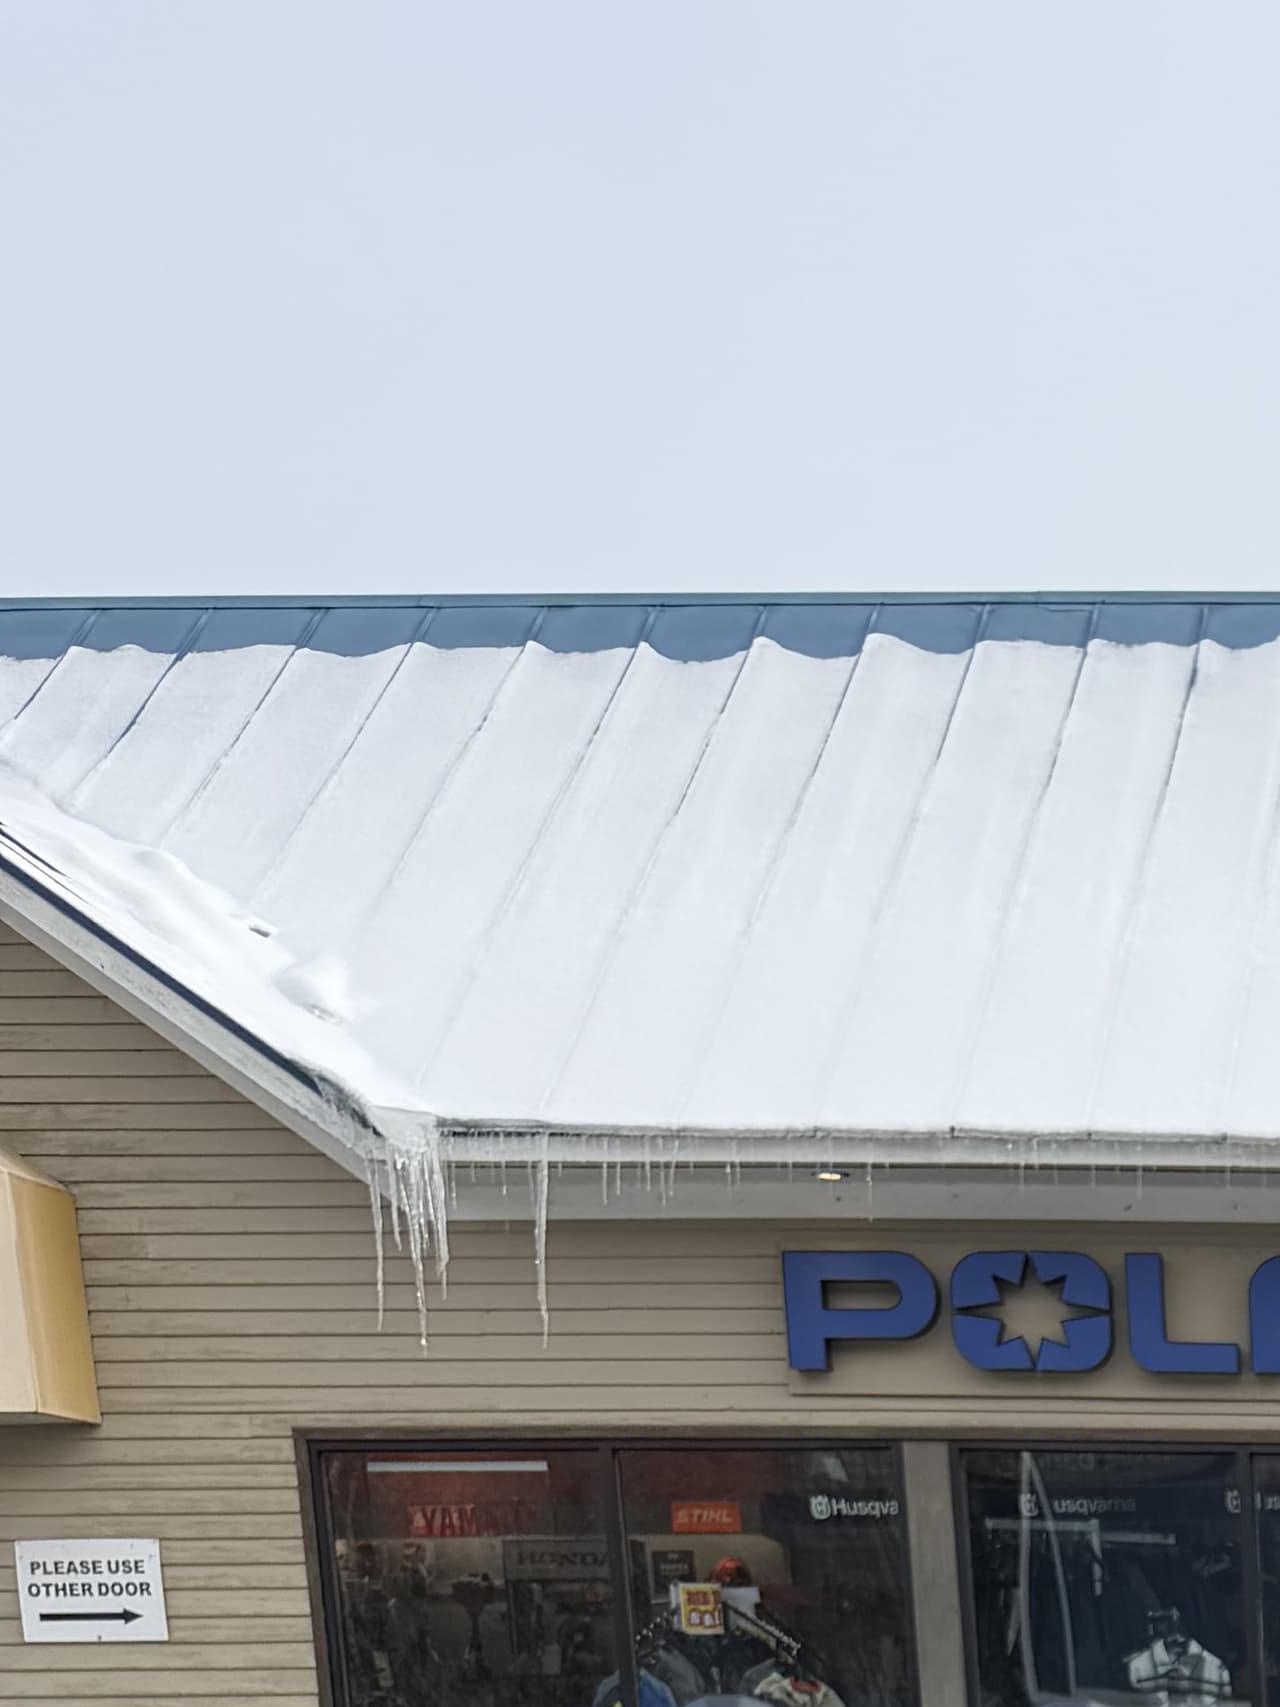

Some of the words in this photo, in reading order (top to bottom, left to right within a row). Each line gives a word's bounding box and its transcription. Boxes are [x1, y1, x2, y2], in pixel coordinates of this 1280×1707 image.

[675, 1507, 733, 1525] STIHL
[1052, 1497, 1137, 1517] usqvarna
[29, 1558, 102, 1576] PLEASE
[105, 1558, 146, 1576] USE
[27, 1581, 94, 1598] OTHER
[97, 1581, 152, 1598] DOOR
